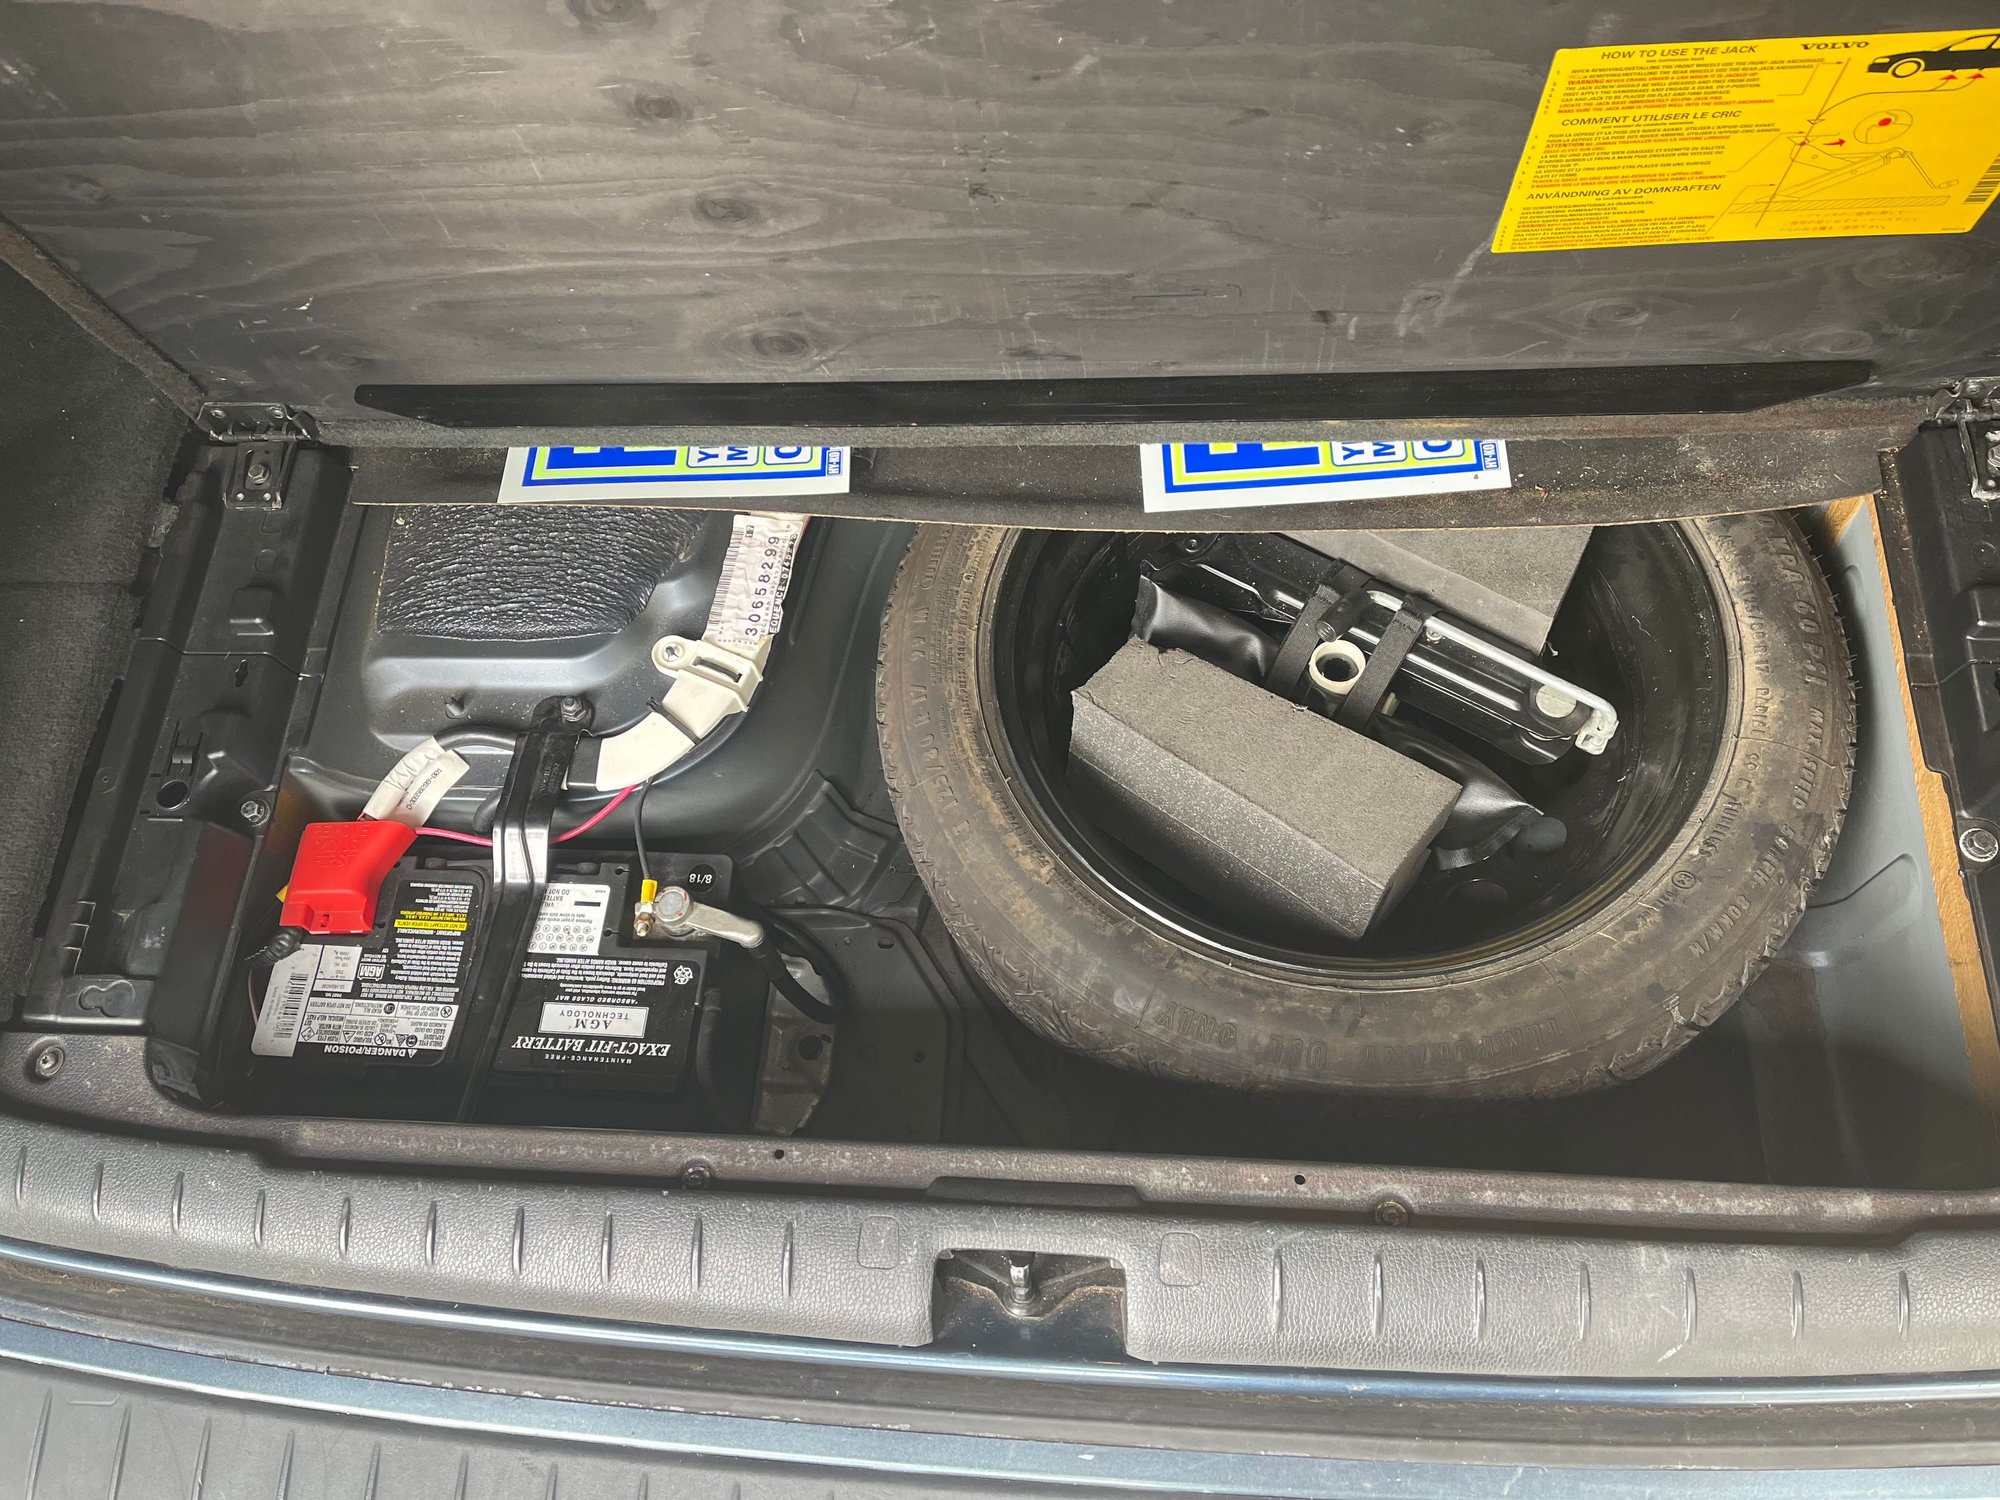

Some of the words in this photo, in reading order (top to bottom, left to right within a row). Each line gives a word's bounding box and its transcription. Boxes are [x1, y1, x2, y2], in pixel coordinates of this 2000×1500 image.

[1601, 51, 1635, 60] HOW
[1639, 49, 1657, 58] TO
[1661, 48, 1689, 57] USE
[1693, 46, 1719, 55] THE
[1721, 45, 1758, 54] JACK
[1800, 41, 1869, 51] VOLVO
[1561, 115, 1629, 126] COMMENT
[1632, 112, 1690, 123] UTILISER
[1693, 111, 1709, 119] LE
[1711, 110, 1742, 119] CRIC
[1526, 189, 1609, 200] ANVÄNDNING
[1613, 188, 1631, 196] AV
[1634, 184, 1722, 195] DOMKRAFTEN
[829, 451, 840, 475] HY-KO
[1483, 444, 1498, 469] HY-KO
[745, 536, 780, 636] 30658299
[910, 636, 925, 661] 99
[909, 683, 927, 705] 17
[689, 873, 713, 885] 8/18
[359, 965, 383, 977] AGM
[572, 995, 595, 1003] GLASS
[559, 1010, 629, 1021] TECHNOLOGY
[574, 1018, 612, 1030] AGM
[1155, 1000, 1238, 1050] ONLY
[323, 1044, 407, 1057] DANGER/POISON
[511, 1036, 586, 1052] BATTERY
[585, 1039, 671, 1057] EXACT-FIT
[544, 1053, 632, 1064] MAINTENANCE-FREE
